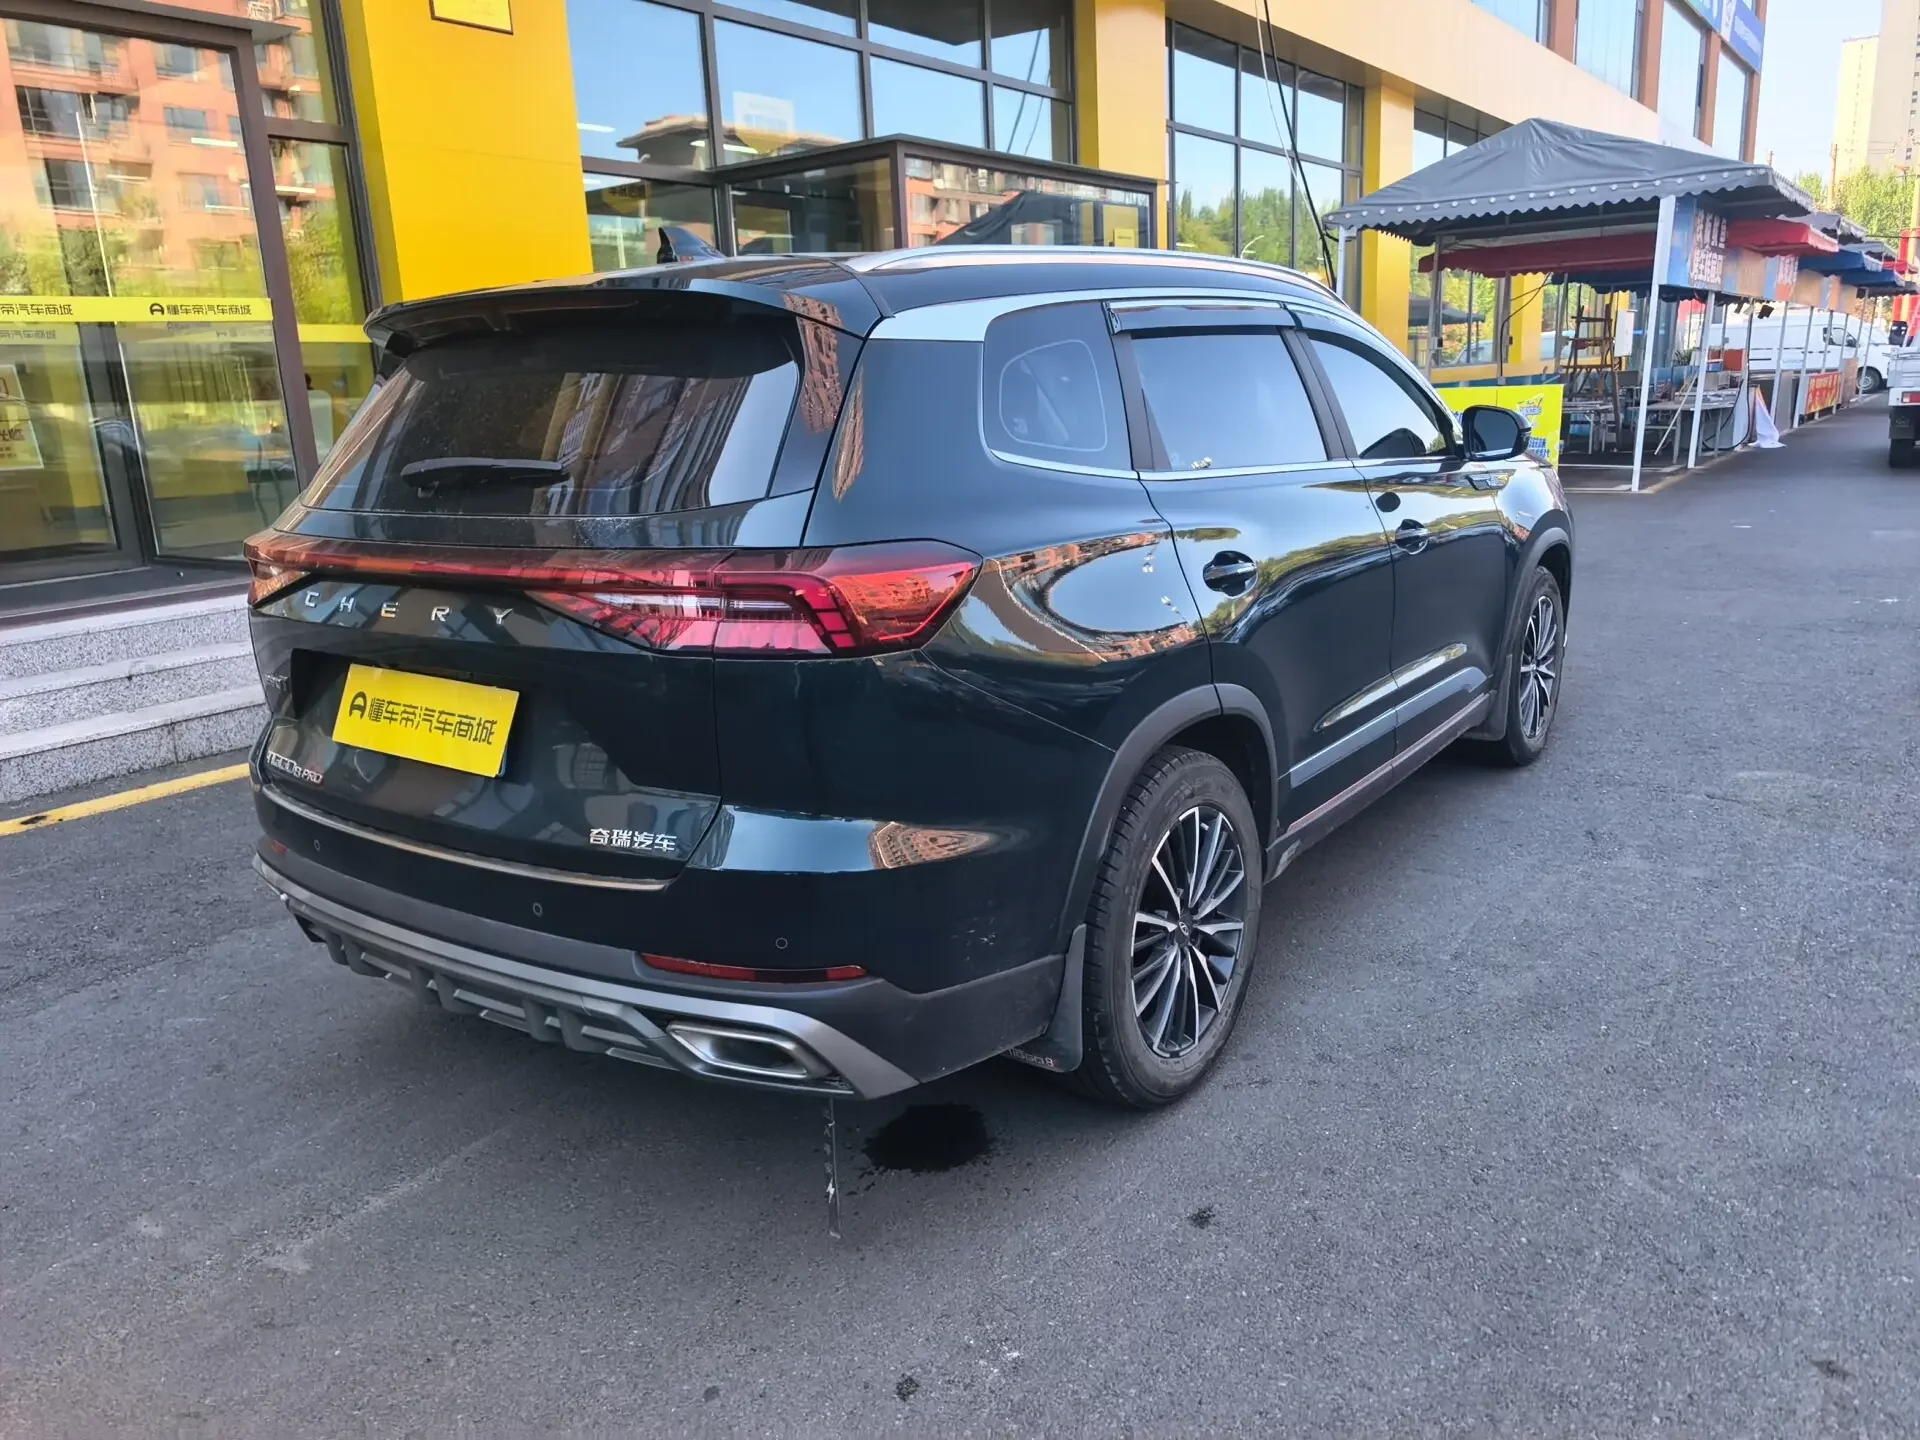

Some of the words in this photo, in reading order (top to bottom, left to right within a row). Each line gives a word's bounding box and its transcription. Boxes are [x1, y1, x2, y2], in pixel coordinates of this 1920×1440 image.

[167, 304, 252, 316] 懂车帝汽车商城
[305, 591, 514, 625] CHERY
[368, 697, 498, 745] 懂车帝汽车商城
[301, 768, 323, 784] PRO
[589, 828, 677, 852] 奇瑞汽车
